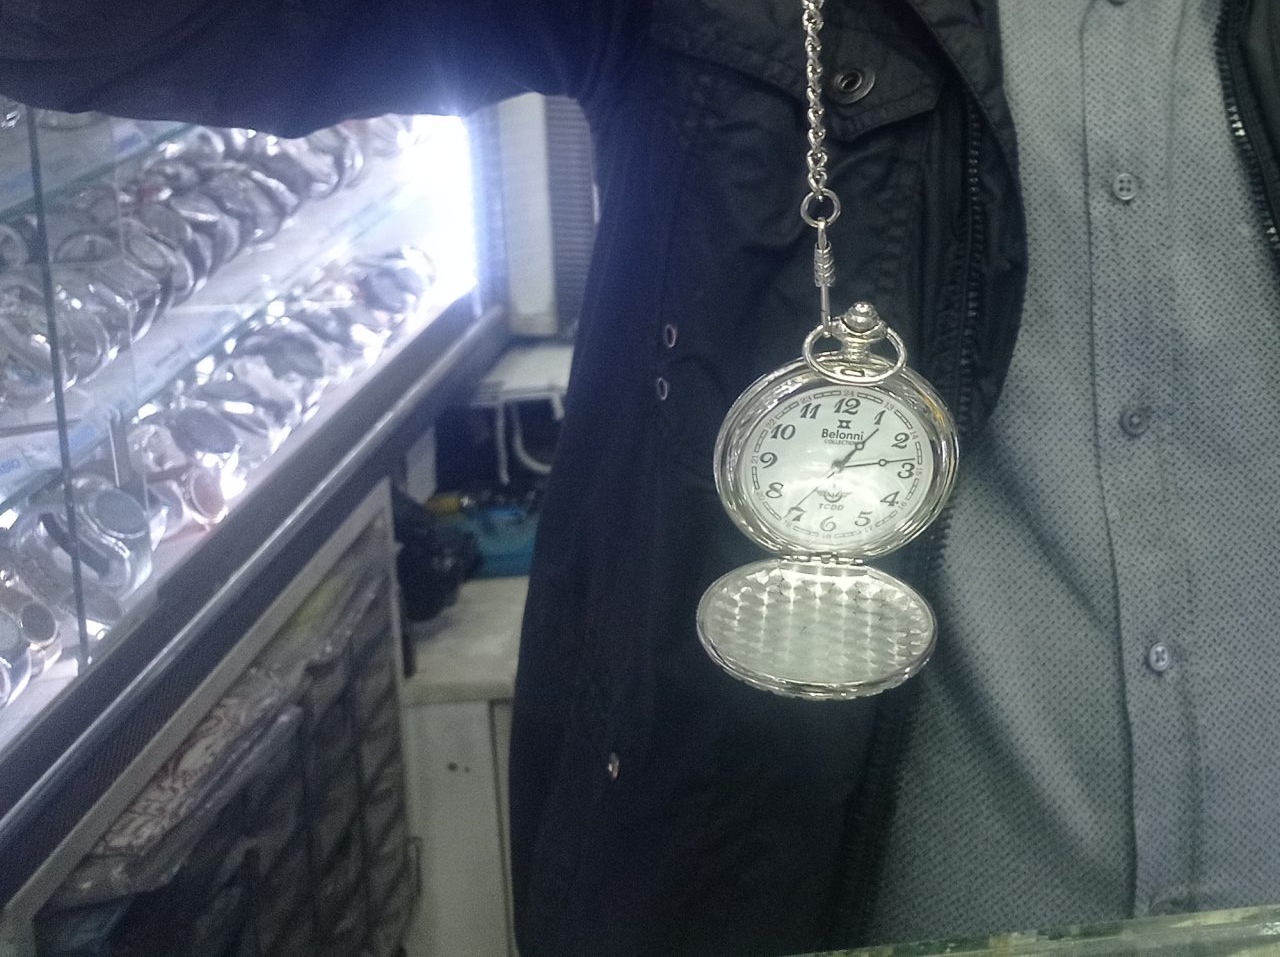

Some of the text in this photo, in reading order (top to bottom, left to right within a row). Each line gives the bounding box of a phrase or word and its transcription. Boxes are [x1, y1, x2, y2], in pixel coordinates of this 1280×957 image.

[800, 402, 823, 420] 11
[834, 397, 862, 416] 12
[874, 409, 887, 426] 1
[770, 423, 796, 441] 10
[821, 428, 865, 442] Belonni
[891, 431, 910, 450] 2
[824, 438, 857, 446] COLLECTIO
[760, 451, 778, 470] 9
[897, 461, 916, 480] 3
[765, 481, 784, 499] 8
[880, 490, 900, 507] 4
[786, 505, 807, 522] 7
[819, 502, 844, 512] TCDD
[819, 515, 837, 533] 6
[854, 510, 873, 527] 5
